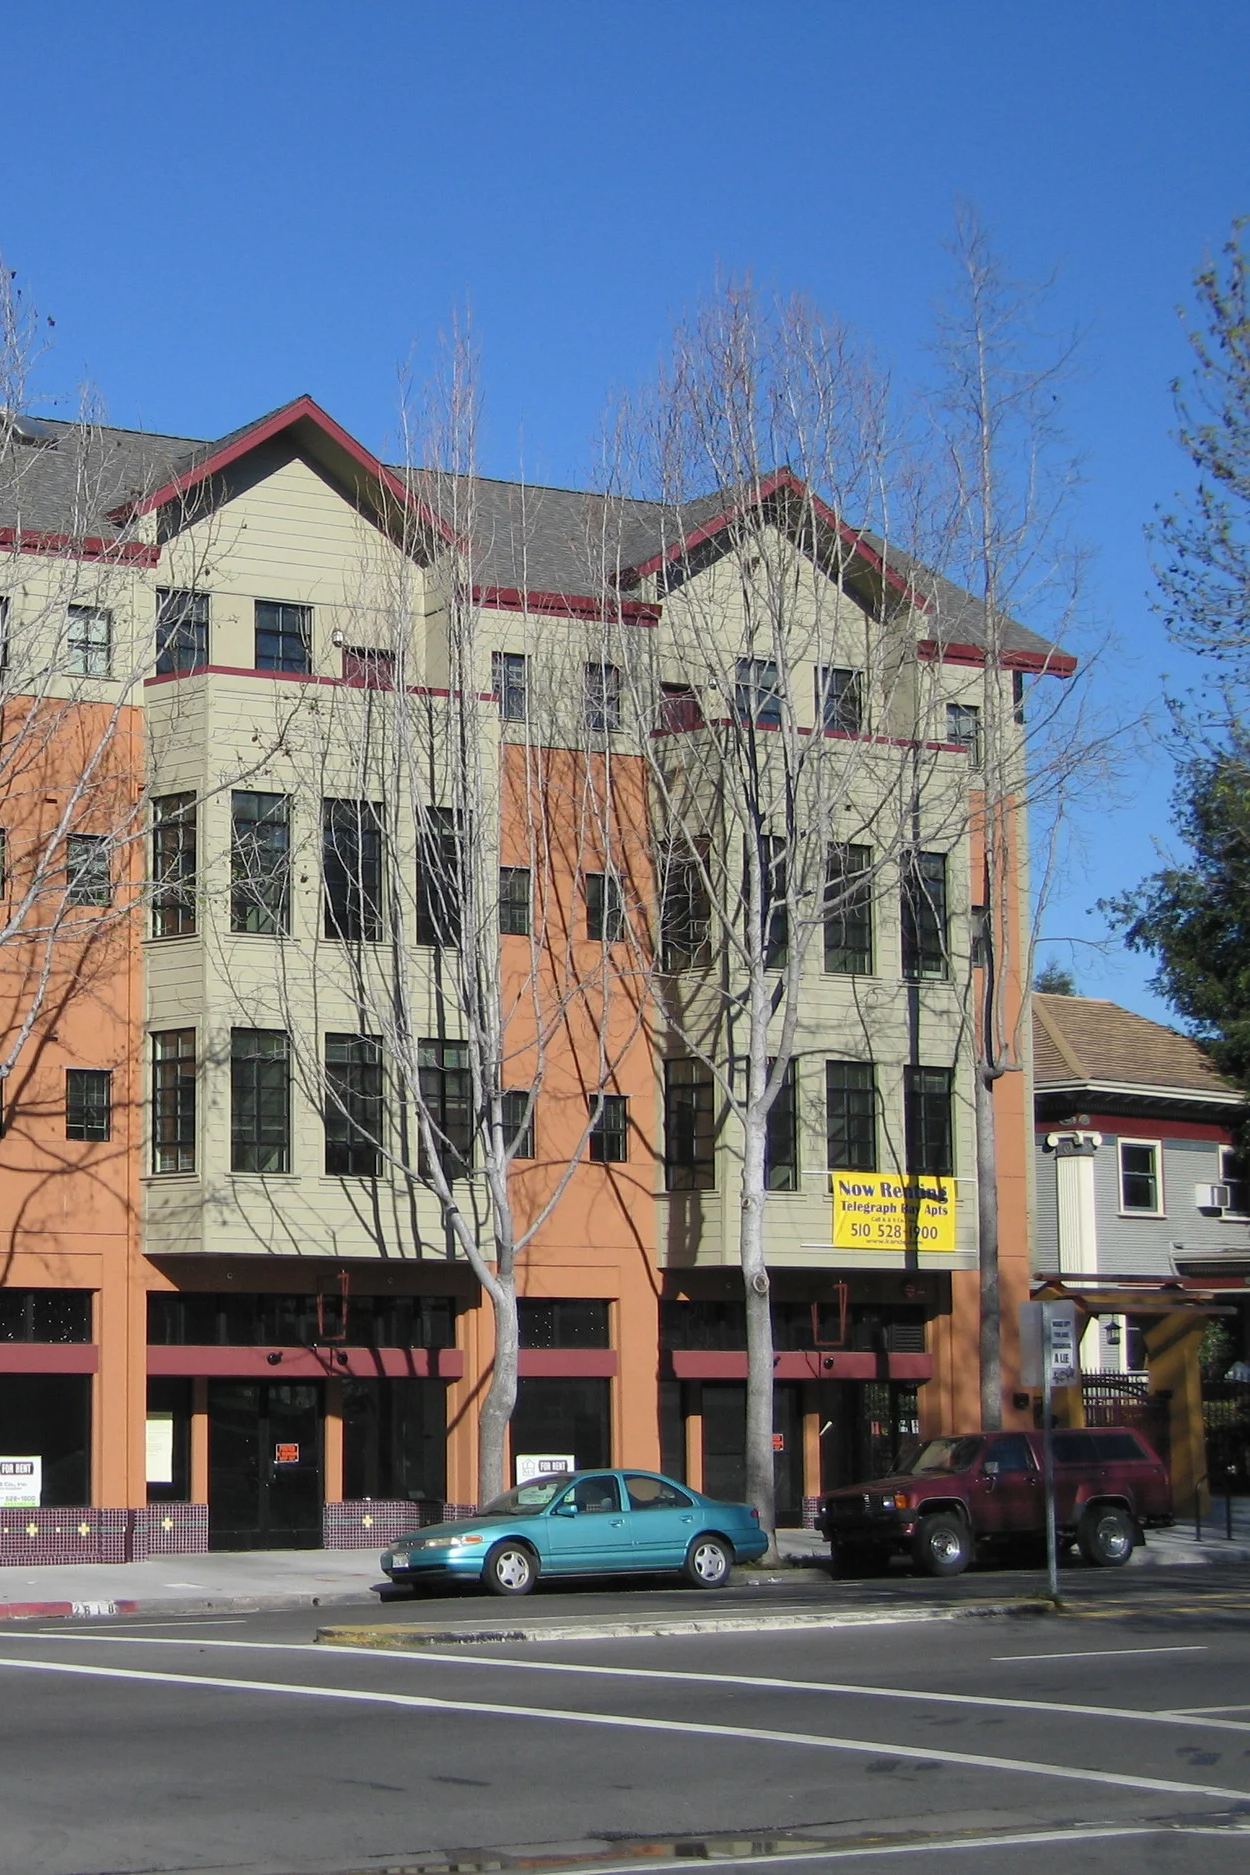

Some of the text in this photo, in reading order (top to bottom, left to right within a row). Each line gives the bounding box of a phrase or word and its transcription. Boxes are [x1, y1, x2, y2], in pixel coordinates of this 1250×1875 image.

[838, 1180, 948, 1204] Now Renting
[841, 1200, 948, 1217] Telegraph Bay Apts
[851, 1223, 938, 1239] 510 528-1900
[1, 1463, 31, 1474] FOR RENT
[540, 1461, 566, 1471] FOR RENT
